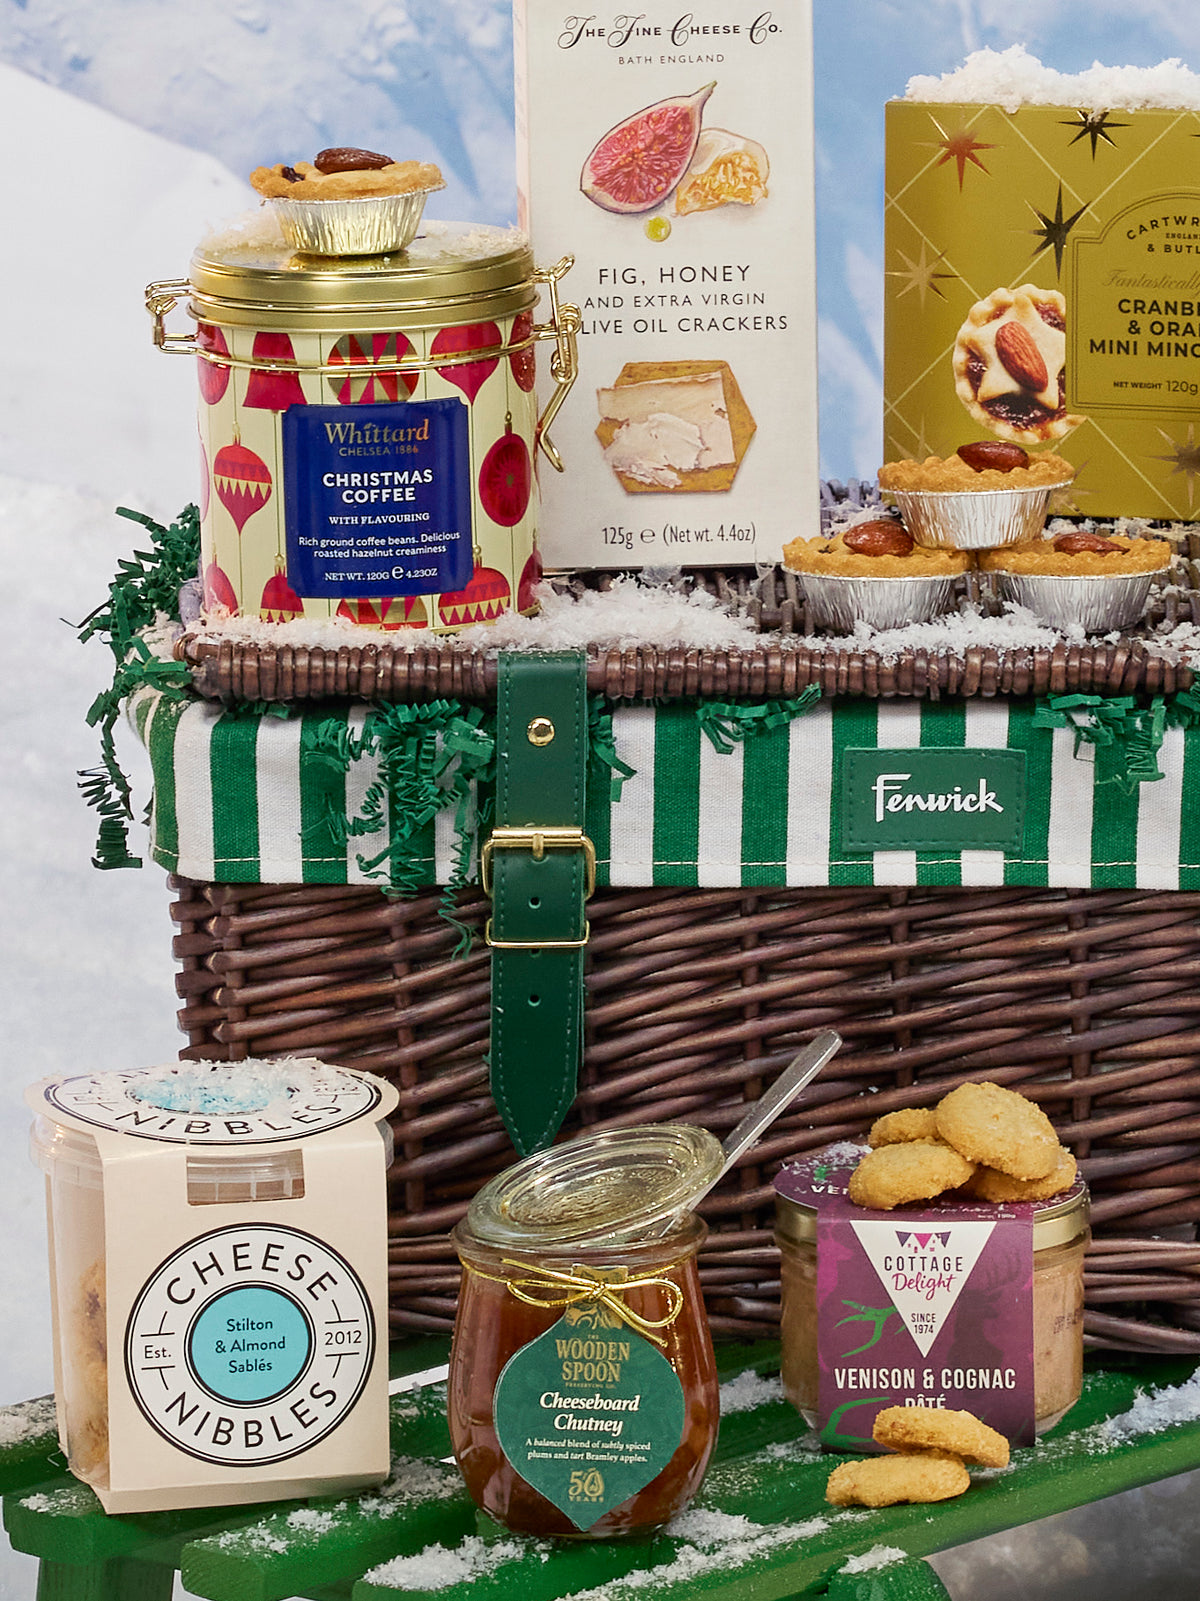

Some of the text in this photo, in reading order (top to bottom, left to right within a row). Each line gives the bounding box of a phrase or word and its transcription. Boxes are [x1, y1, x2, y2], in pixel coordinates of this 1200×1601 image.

[557, 15, 606, 49] THE
[607, 13, 662, 48] FINE
[667, 13, 741, 46] CHEESE
[618, 54, 725, 65] BATH ENGLAND
[1126, 215, 1200, 240] CARTWR
[1165, 232, 1200, 240] ENGLAN
[1147, 243, 1155, 252] &
[599, 265, 751, 286] FIG, HONEY
[584, 292, 765, 309] AND EXTRA VIRGIN
[1117, 298, 1200, 317] CRANB
[581, 316, 788, 335] LIVE OIL CRACKERS
[1128, 320, 1200, 337] & ORA
[1089, 338, 1138, 356] MINI
[1113, 380, 1199, 396] NET WEIGHT 120g
[324, 418, 430, 445] Whittard
[339, 445, 419, 457] CHELSEA 1886
[322, 469, 434, 487] CHRISTMAS
[342, 487, 416, 504] COFFEE
[329, 513, 430, 525] WITH FLAVOURING
[299, 531, 461, 549] Rich ground coffee beans. Delicious
[601, 526, 634, 550] 125g
[663, 523, 690, 547] (Net
[694, 529, 714, 543] wt.
[717, 521, 757, 544] 4.4oz)
[314, 545, 447, 558] roasted hazelnut creaminess
[325, 572, 345, 581] NET
[367, 571, 390, 581] 120G
[406, 567, 438, 579] 4.23OZ
[871, 774, 1004, 822] Fenwick
[884, 1256, 963, 1272] COTTAGE
[167, 1242, 338, 1306] CHEESE
[891, 1271, 957, 1301] Delight
[226, 1317, 273, 1332] Stilton
[911, 1313, 936, 1323] SINCE
[914, 1324, 934, 1334] 1974
[215, 1336, 286, 1353] & Almond
[324, 1329, 363, 1347] 2012
[144, 1345, 172, 1360] Est.
[555, 1337, 631, 1362] WOODEN
[228, 1358, 273, 1375] Sablés
[562, 1360, 621, 1383] SPOON
[834, 1367, 1017, 1390] VENISON & COGNAC
[539, 1391, 641, 1411] Cheeseboard
[165, 1381, 338, 1449] NIBBLES
[553, 1413, 624, 1437] Chutney
[526, 1438, 533, 1446] A
[567, 1439, 590, 1448] blend
[591, 1440, 601, 1449] of
[625, 1442, 651, 1453] spiced
[527, 1450, 648, 1464] plums and tart Bramley apples.
